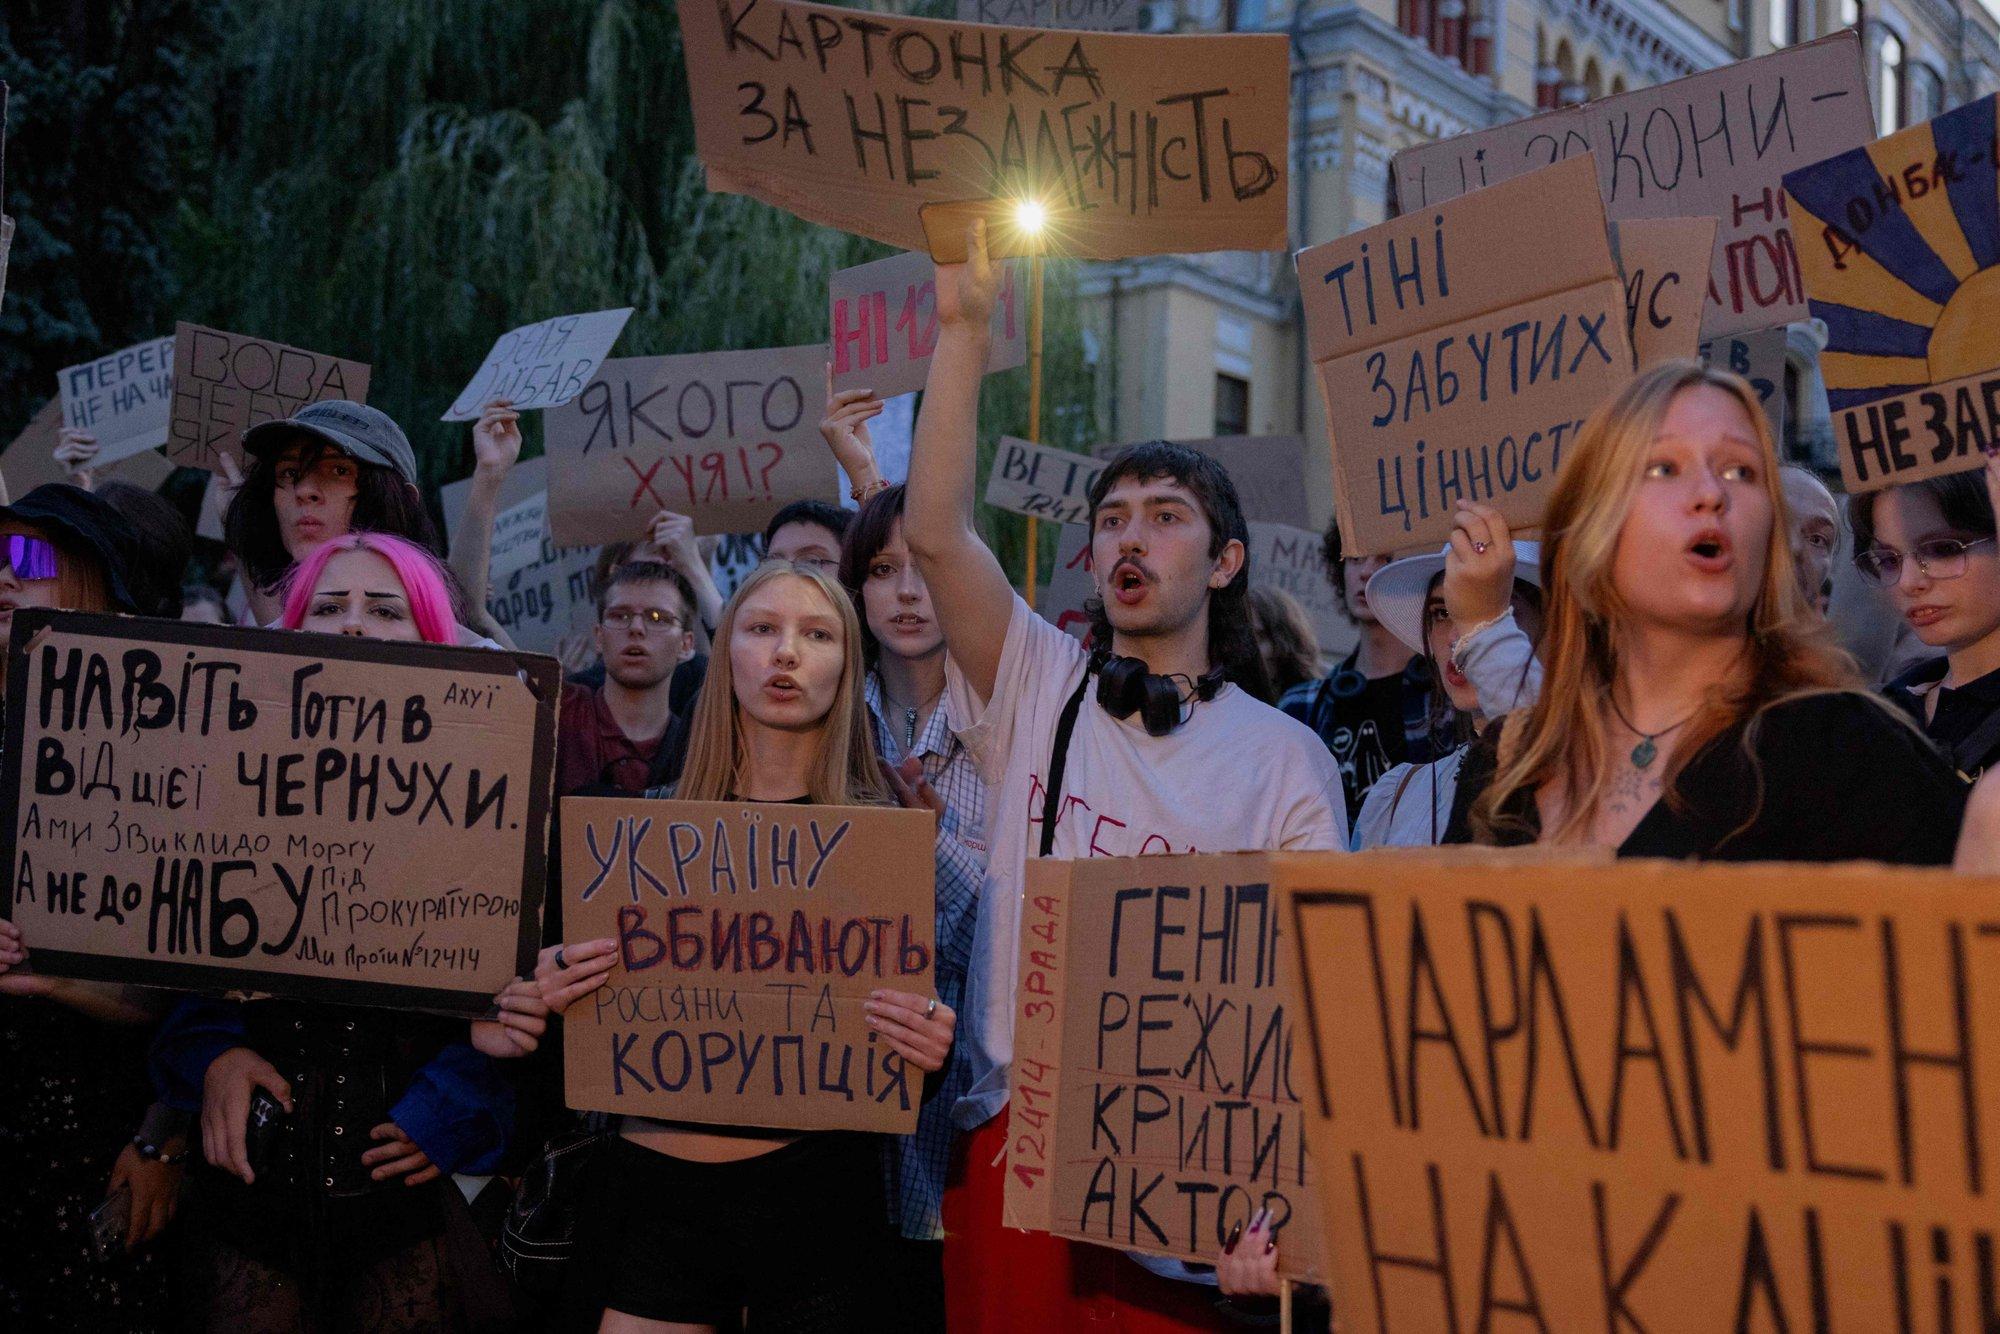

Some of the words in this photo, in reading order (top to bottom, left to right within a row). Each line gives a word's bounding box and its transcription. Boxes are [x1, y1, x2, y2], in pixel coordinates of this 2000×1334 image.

[719, 0, 1104, 96] КАРТОНКА
[737, 81, 817, 156] ЗА
[190, 329, 348, 401] ВОВА
[834, 290, 889, 374] НІ
[1366, 312, 1612, 428] ЗАБУТИХ
[174, 374, 237, 426] НЕ
[580, 375, 804, 454] ЯКОГО
[624, 442, 785, 509] ХУЯ!?
[237, 747, 519, 830] ЧЕРНУХИ.
[582, 809, 851, 902] УКРАЇНУ
[16, 850, 36, 904] А
[46, 870, 88, 915] НЕ
[148, 856, 315, 959] НАБУ
[617, 904, 931, 979] ВБИВАЮТЬ
[1023, 895, 1061, 1024] ЗРАДА
[764, 983, 836, 1033] ТА
[1290, 888, 2000, 1200] ПАРЛАМЕН
[1013, 1057, 1060, 1190] 12414
